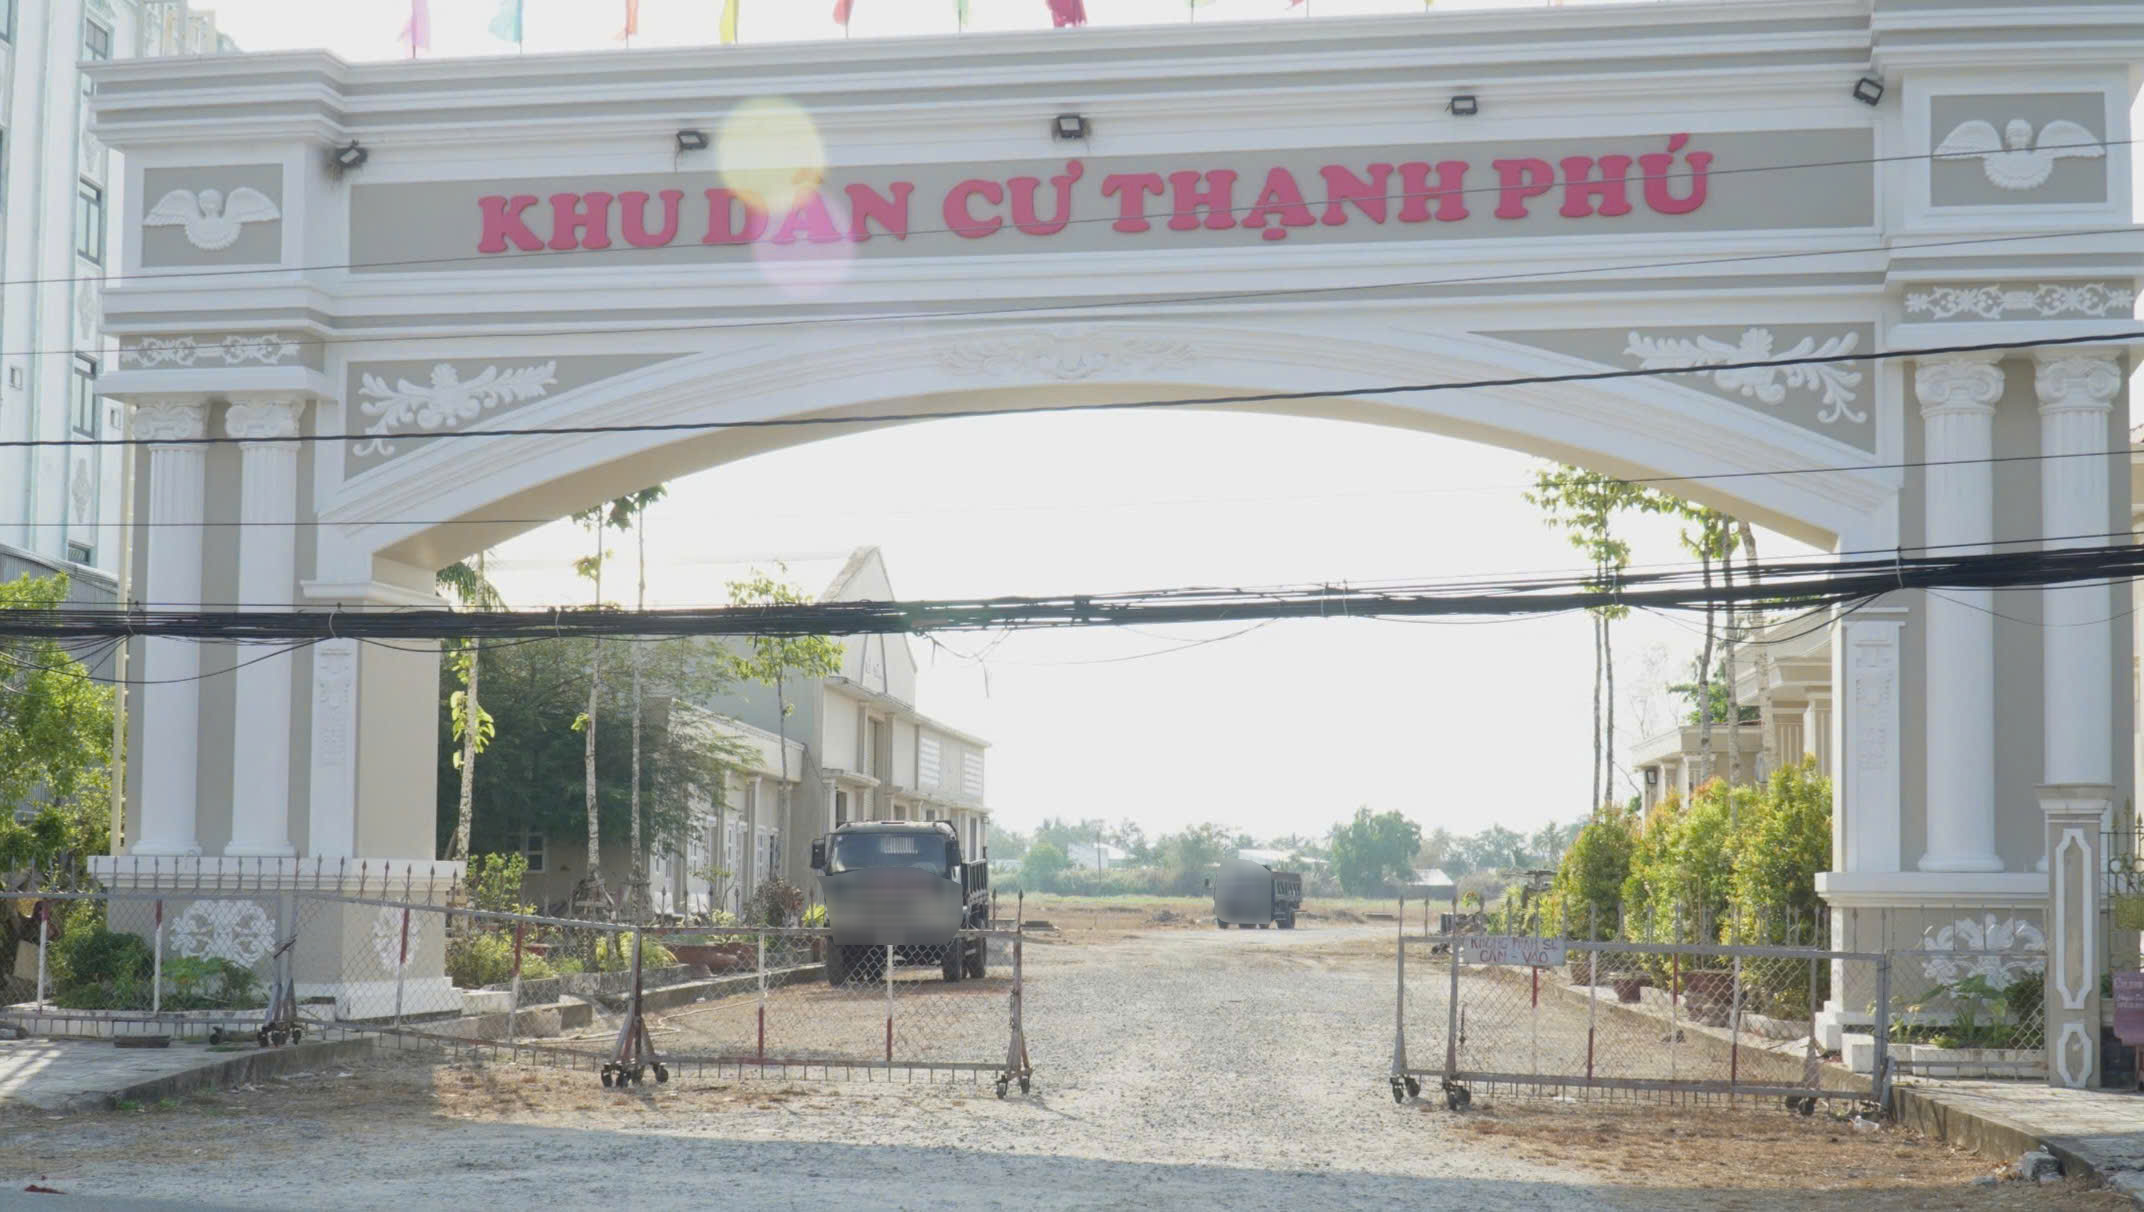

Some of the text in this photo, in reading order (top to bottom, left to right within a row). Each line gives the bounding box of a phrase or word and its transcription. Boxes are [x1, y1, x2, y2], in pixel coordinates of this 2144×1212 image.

[478, 133, 1713, 253] KHU DÂN CƯ THẠNH PHÚ
